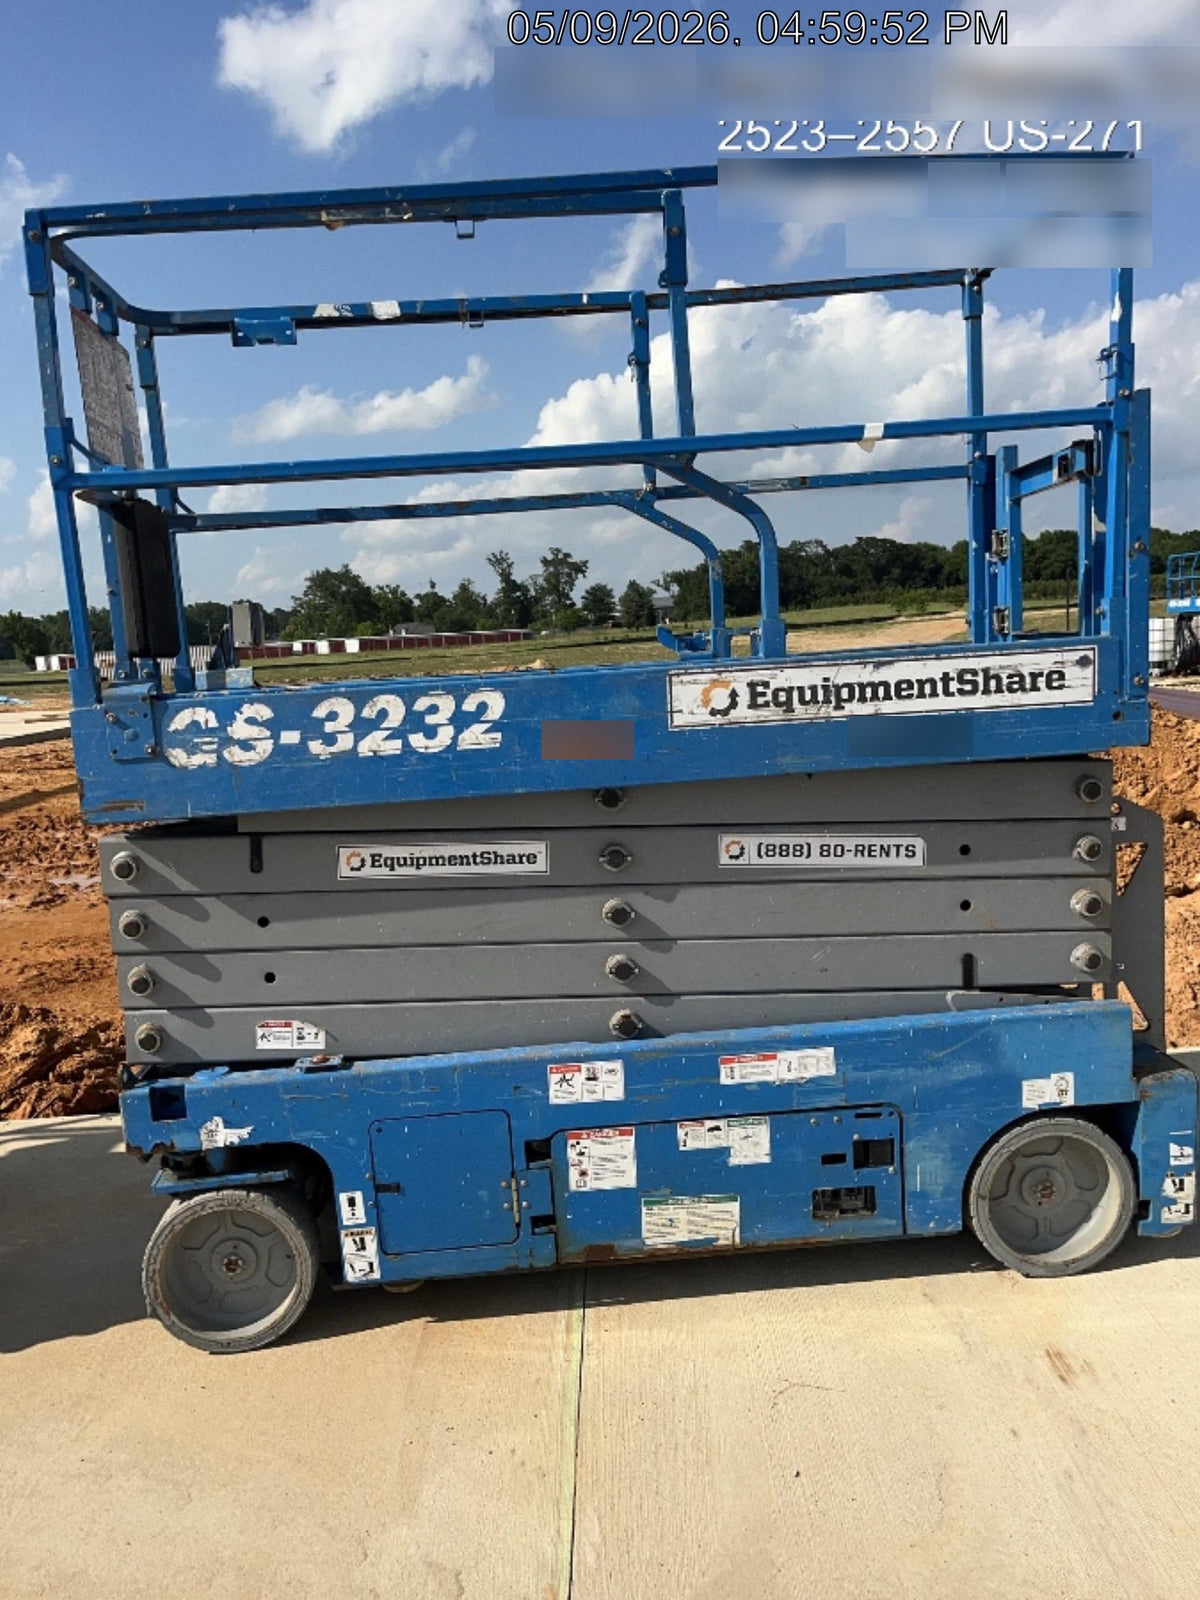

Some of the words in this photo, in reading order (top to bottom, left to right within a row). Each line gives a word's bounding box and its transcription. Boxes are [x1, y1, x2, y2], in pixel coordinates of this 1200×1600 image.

[746, 667, 1066, 712] EquipmentShare
[165, 688, 506, 769] GS-3232
[369, 851, 538, 871] EquipmentShare
[757, 842, 812, 859] (888)
[819, 842, 917, 859] 80-RENTS
